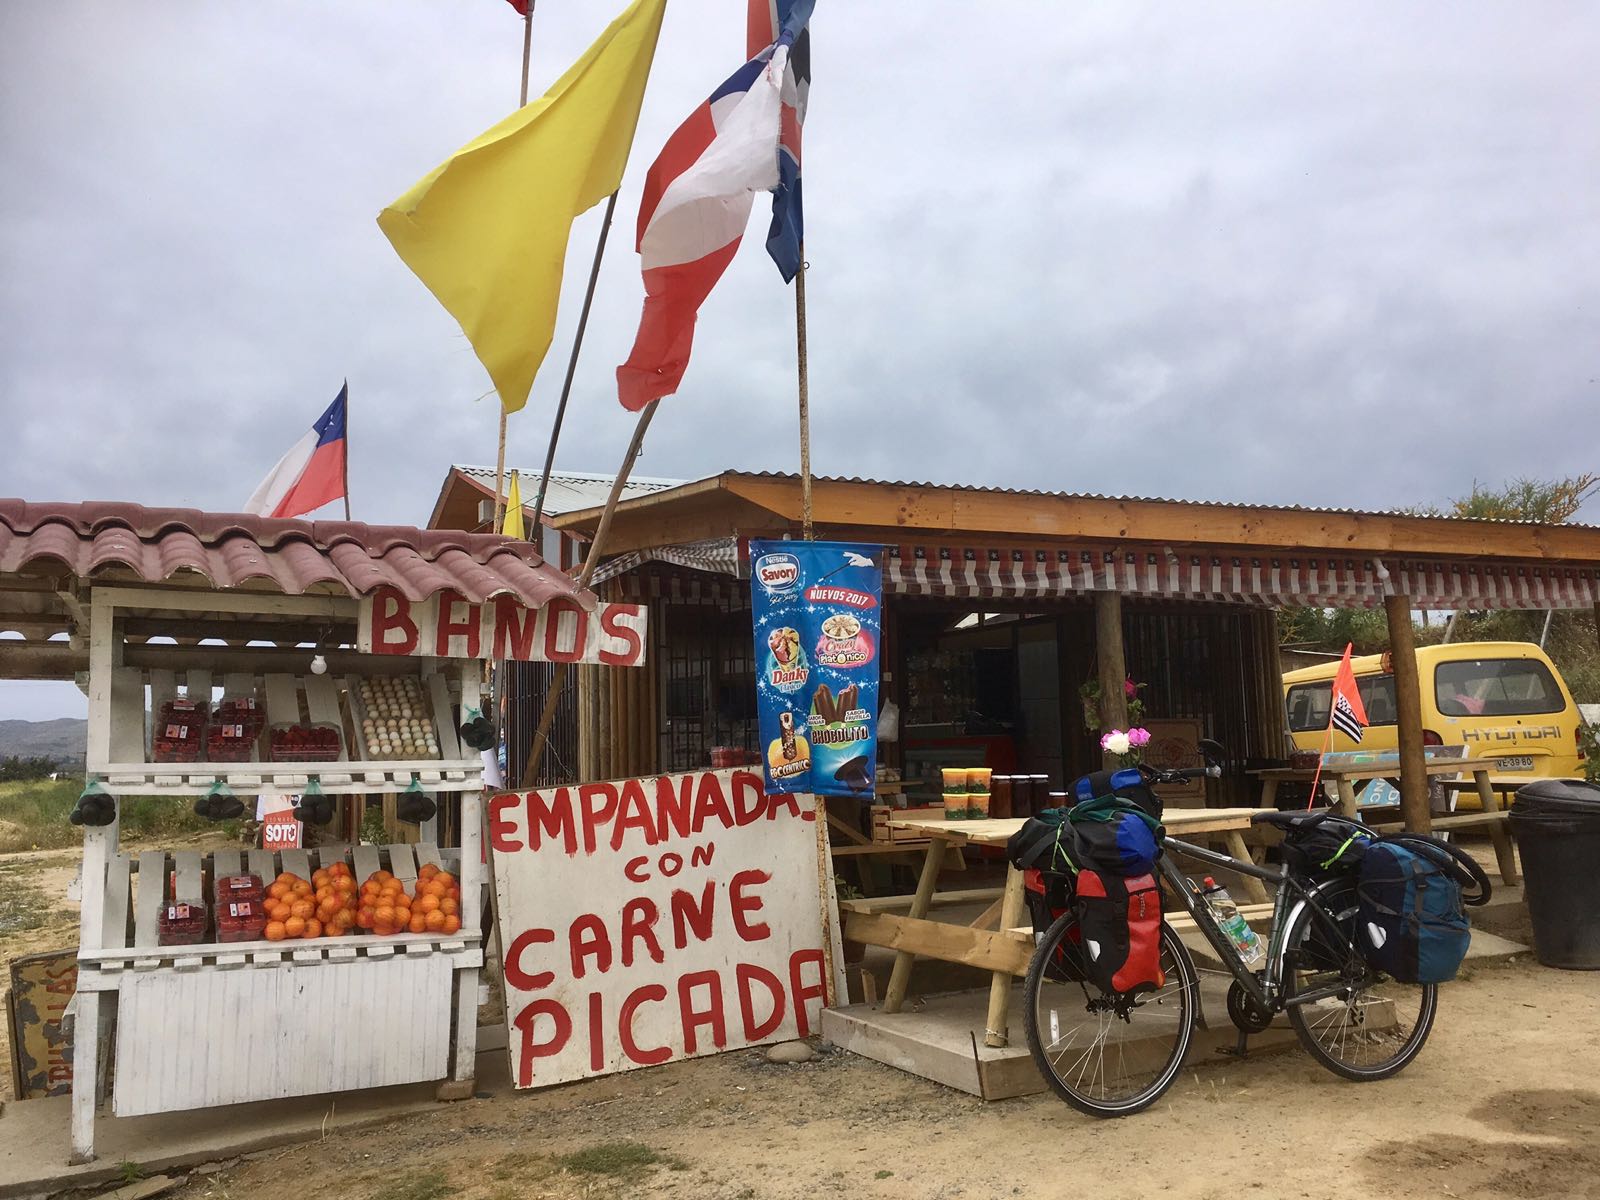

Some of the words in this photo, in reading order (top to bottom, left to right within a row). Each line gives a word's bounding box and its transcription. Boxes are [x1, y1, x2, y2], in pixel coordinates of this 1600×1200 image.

[761, 567, 796, 582] Savory
[810, 589, 844, 601] NUEVOS
[845, 592, 869, 606] 2017
[772, 667, 808, 684] Danky
[812, 725, 869, 745] CHOCOLITO
[1461, 726, 1562, 741] HYUNDAI
[488, 770, 817, 858] EMPANADA
[265, 824, 297, 842] SOTO
[624, 841, 716, 884] CON
[504, 868, 773, 993] CARNE
[513, 948, 829, 1088] PICADA
